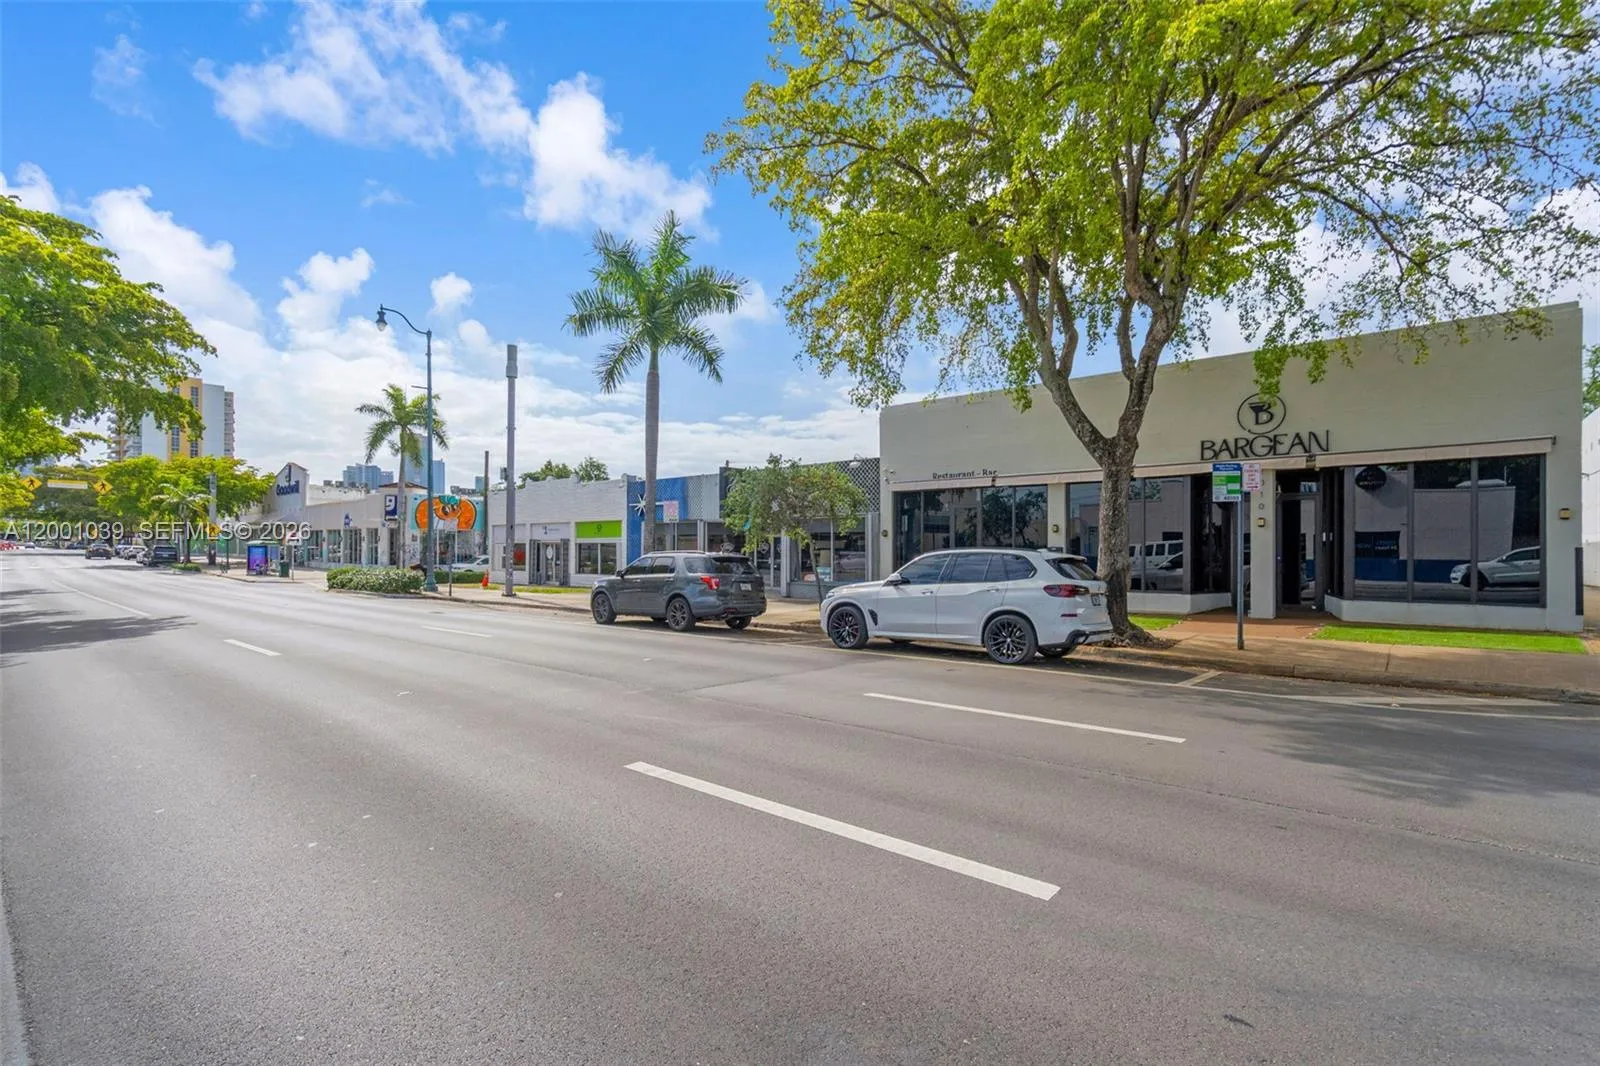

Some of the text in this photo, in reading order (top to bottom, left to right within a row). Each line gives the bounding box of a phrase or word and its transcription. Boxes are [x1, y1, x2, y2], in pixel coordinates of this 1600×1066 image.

[1200, 430, 1330, 460] BARGEAN
[932, 470, 975, 479] Restaurant
[982, 468, 998, 476] Bar
